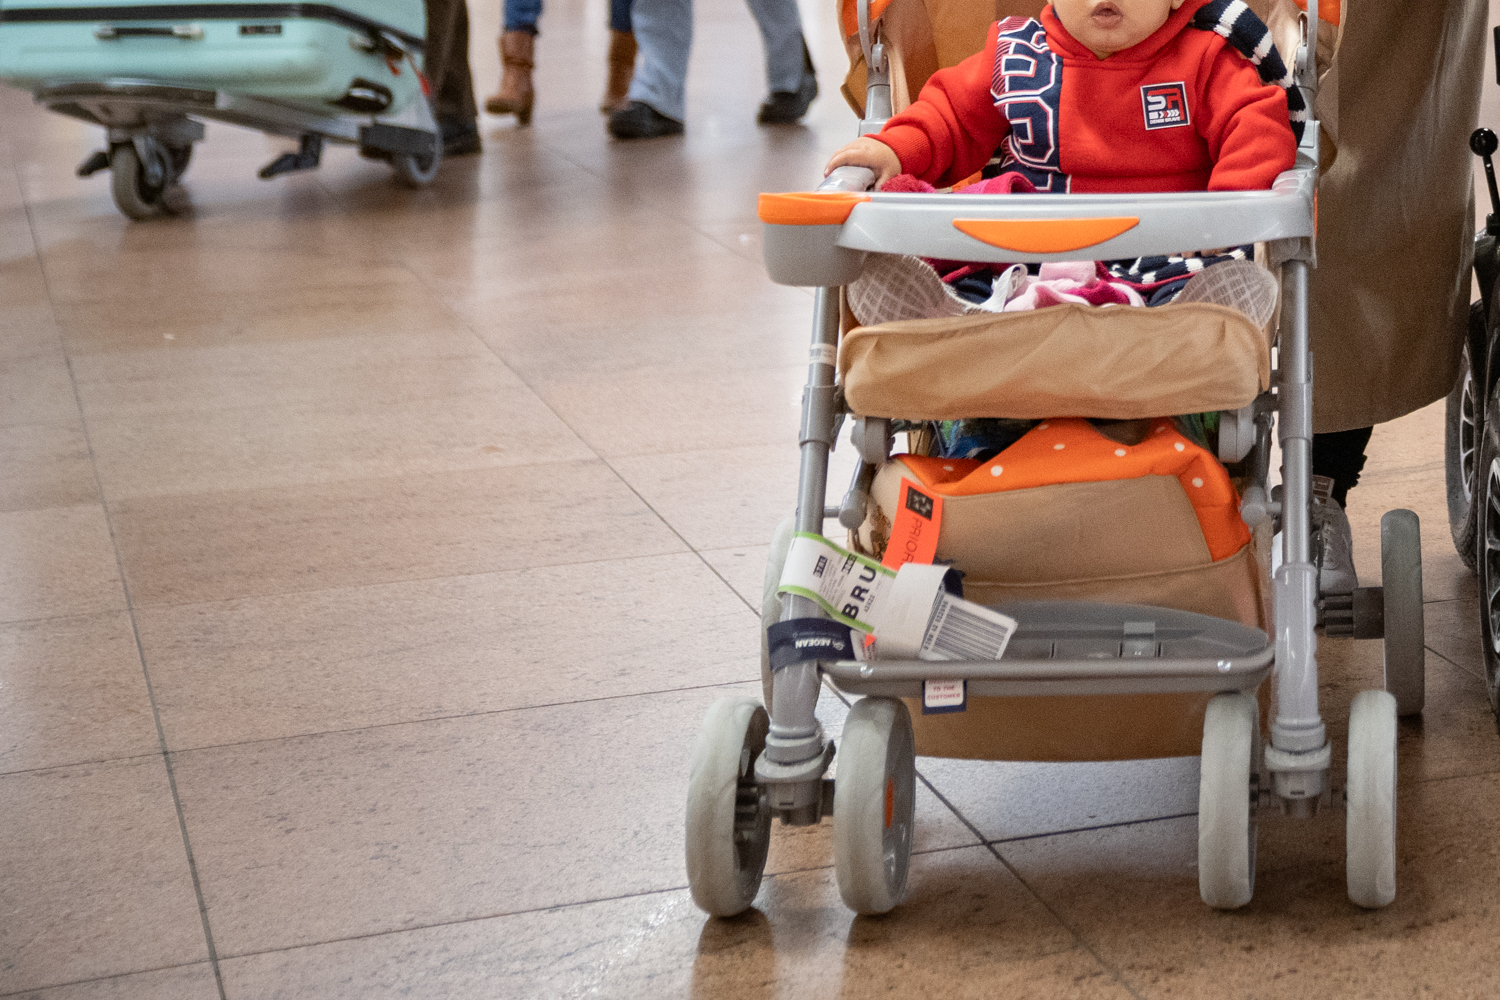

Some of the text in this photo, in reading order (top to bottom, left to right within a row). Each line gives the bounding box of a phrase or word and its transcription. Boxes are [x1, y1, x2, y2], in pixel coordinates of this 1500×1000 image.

[902, 518, 923, 565] PRIOR
[841, 565, 877, 620] BRU
[795, 638, 832, 650] AEGEAN
